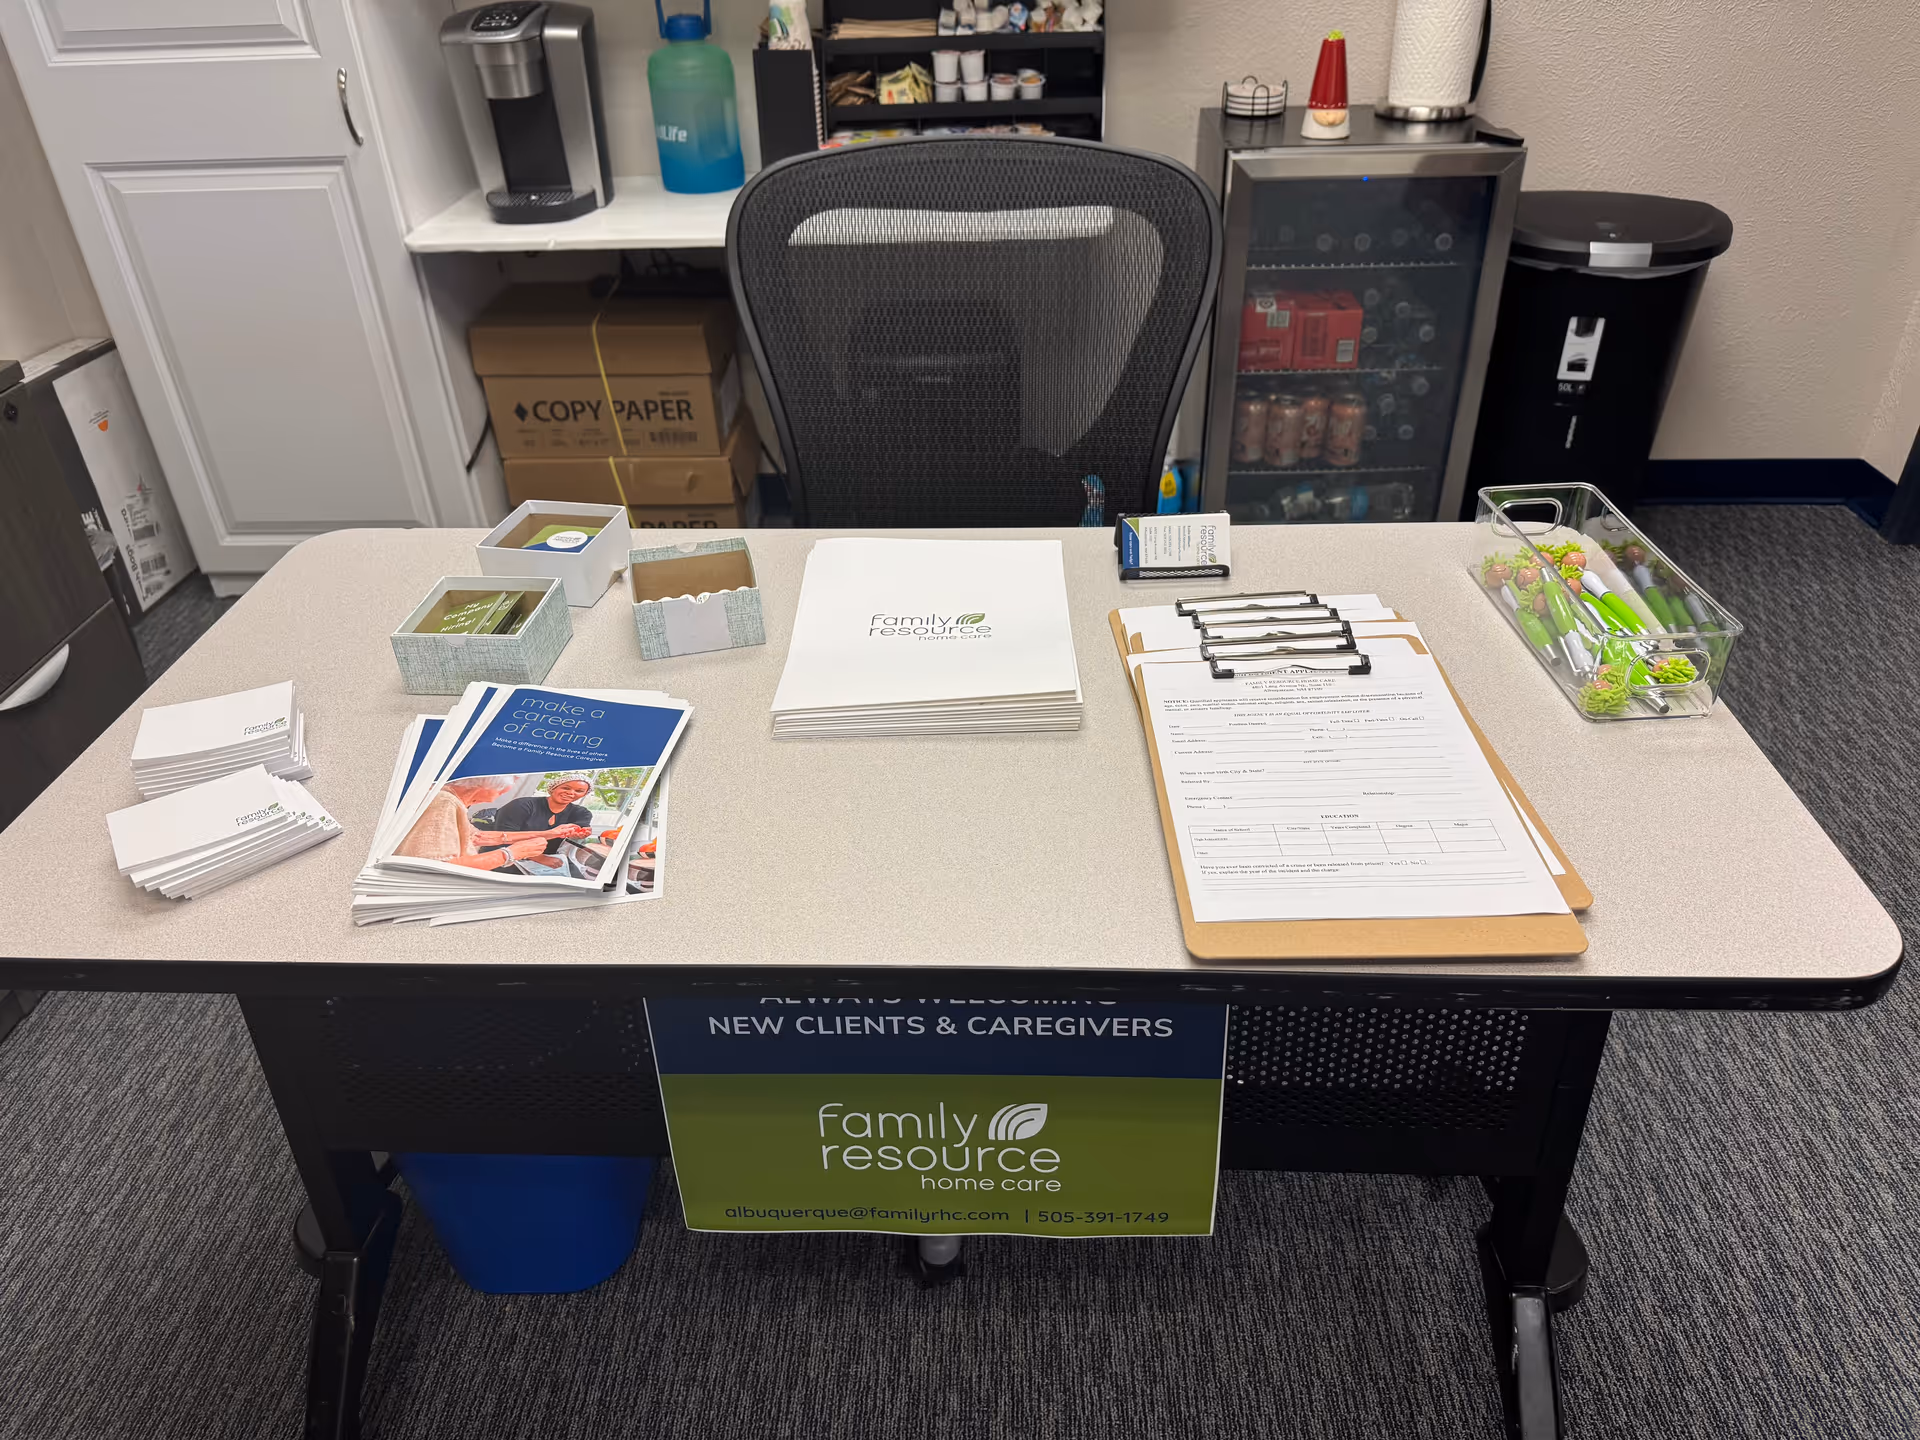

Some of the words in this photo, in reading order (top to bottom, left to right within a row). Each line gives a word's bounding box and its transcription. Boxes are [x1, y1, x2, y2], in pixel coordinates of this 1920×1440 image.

[533, 400, 602, 422] COPY
[612, 399, 694, 421] PAPER
[1207, 525, 1216, 553] family
[443, 602, 494, 621] Company
[465, 602, 480, 610] My
[440, 617, 477, 633] Hiring!
[871, 613, 952, 628] family
[869, 625, 992, 637] resource
[521, 697, 585, 716] make
[590, 708, 606, 719] a
[243, 720, 287, 736] resource
[244, 721, 273, 732] family
[512, 709, 586, 729] career
[503, 722, 528, 735] of
[531, 726, 604, 749] caring
[492, 742, 516, 750] Become
[524, 747, 545, 755] Family
[546, 751, 574, 759] Resource
[518, 741, 548, 750] difference
[236, 807, 267, 823] family
[237, 805, 285, 827] resource
[708, 1016, 784, 1036] NEW
[795, 1016, 926, 1035] CLIENTS
[936, 1016, 957, 1035] &
[967, 1016, 1173, 1038] CAREGIVERS
[818, 1102, 978, 1148] family
[821, 1145, 1061, 1173] resource
[921, 1174, 995, 1191] home
[1001, 1178, 1062, 1192] care
[725, 1206, 1009, 1223] albuquerque@familyrhc.com
[1038, 1210, 1170, 1224] 505-391-1749
